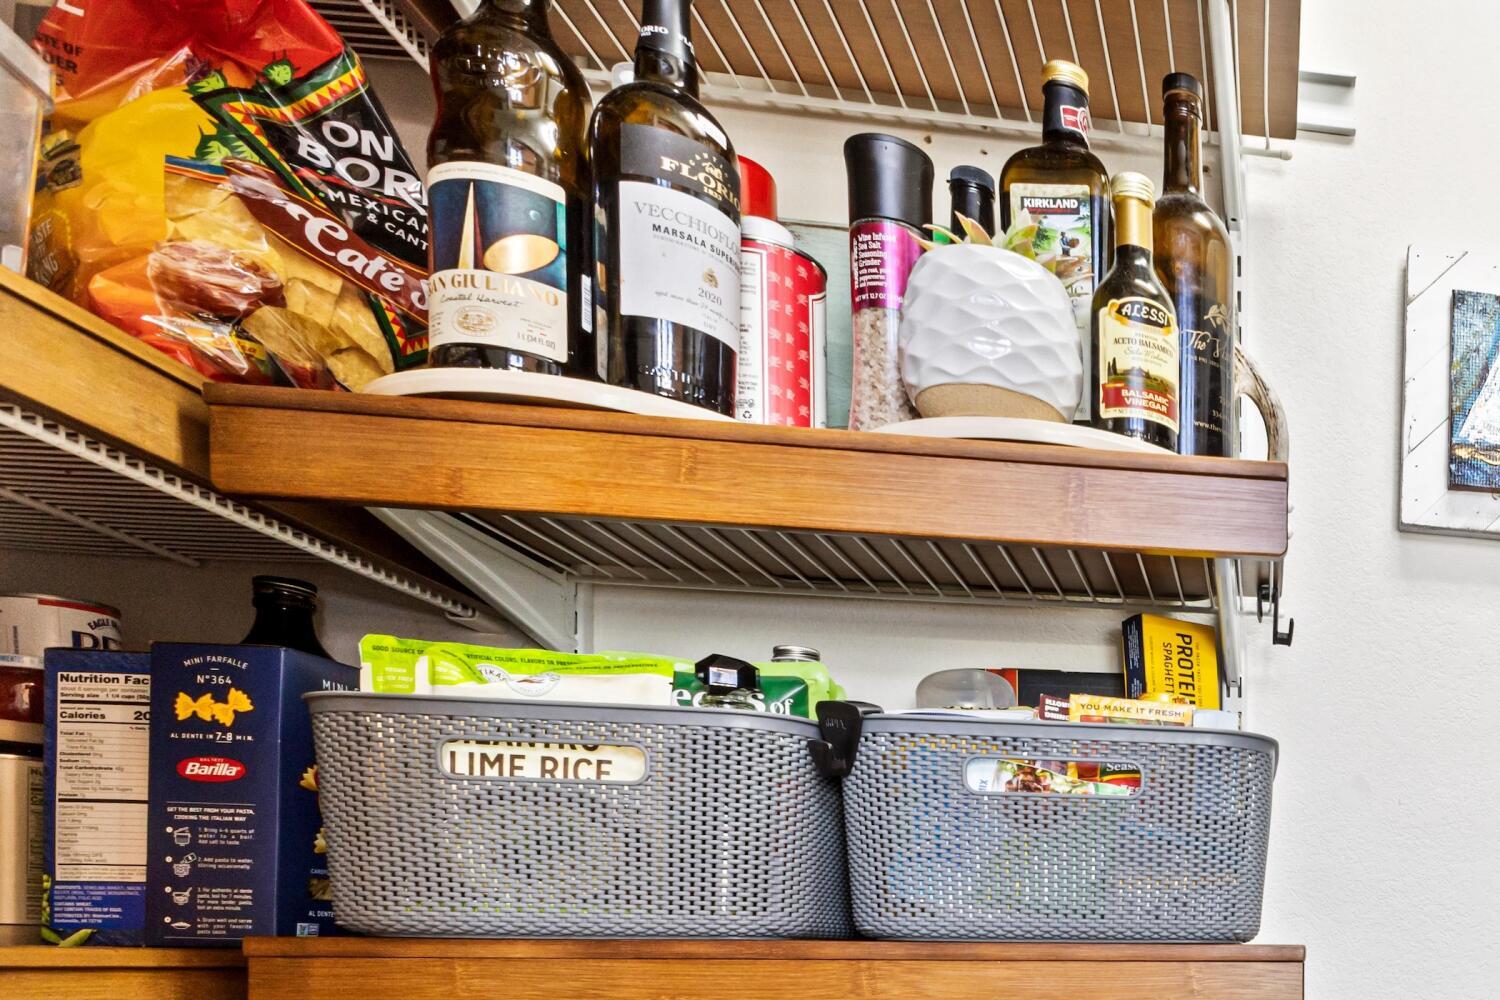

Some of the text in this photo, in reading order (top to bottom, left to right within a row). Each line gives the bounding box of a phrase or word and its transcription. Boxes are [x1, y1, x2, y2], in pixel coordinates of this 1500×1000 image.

[322, 120, 394, 162] ON
[660, 155, 741, 212] FLORIO
[1023, 198, 1079, 209] KIRKLAND
[366, 213, 429, 251] & CANT
[652, 223, 707, 249] MARSALA
[868, 241, 881, 249] Salt
[698, 287, 723, 306] 2020
[1121, 303, 1168, 326] ALESSI
[1121, 389, 1169, 407] BALSAMIC
[1124, 397, 1168, 413] VINEGAR
[183, 655, 249, 670] MINI FARFALLE
[1163, 642, 1175, 695] SPAGHETT
[59, 673, 150, 685] Nutrition Fac
[59, 711, 106, 720] Calories
[768, 698, 795, 716] of
[1080, 702, 1102, 711] YOU
[1103, 704, 1133, 713] MAKE
[1135, 706, 1147, 714] IT
[215, 731, 233, 742] 7-8
[185, 761, 238, 777] Barilla
[449, 750, 614, 781] LIME RICE
